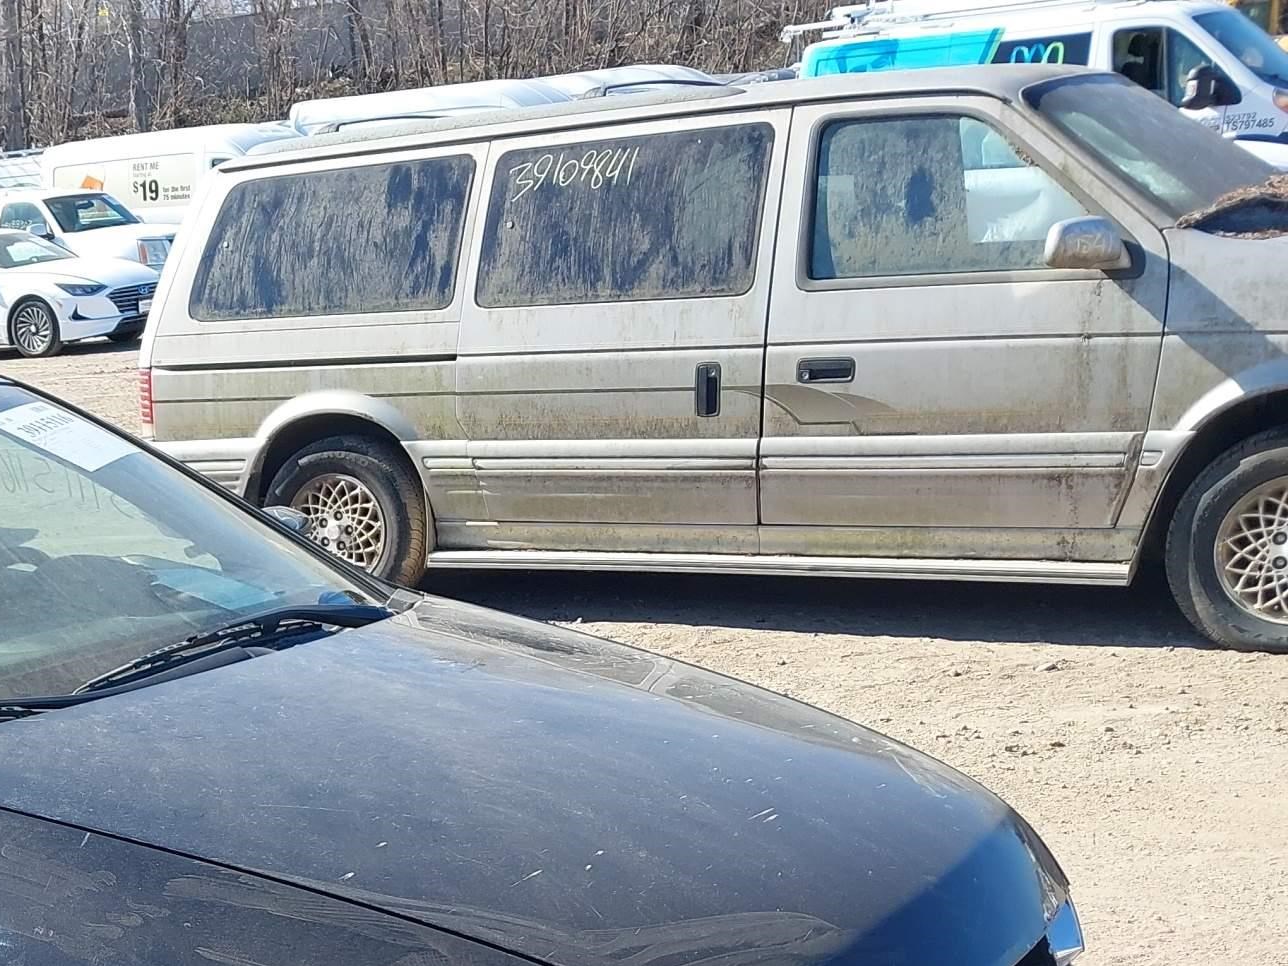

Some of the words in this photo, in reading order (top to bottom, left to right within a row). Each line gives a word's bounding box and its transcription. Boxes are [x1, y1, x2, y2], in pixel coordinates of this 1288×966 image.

[133, 163, 148, 171] RENT
[150, 161, 160, 170] ME
[510, 147, 640, 202] 39109841
[133, 179, 159, 201] $19
